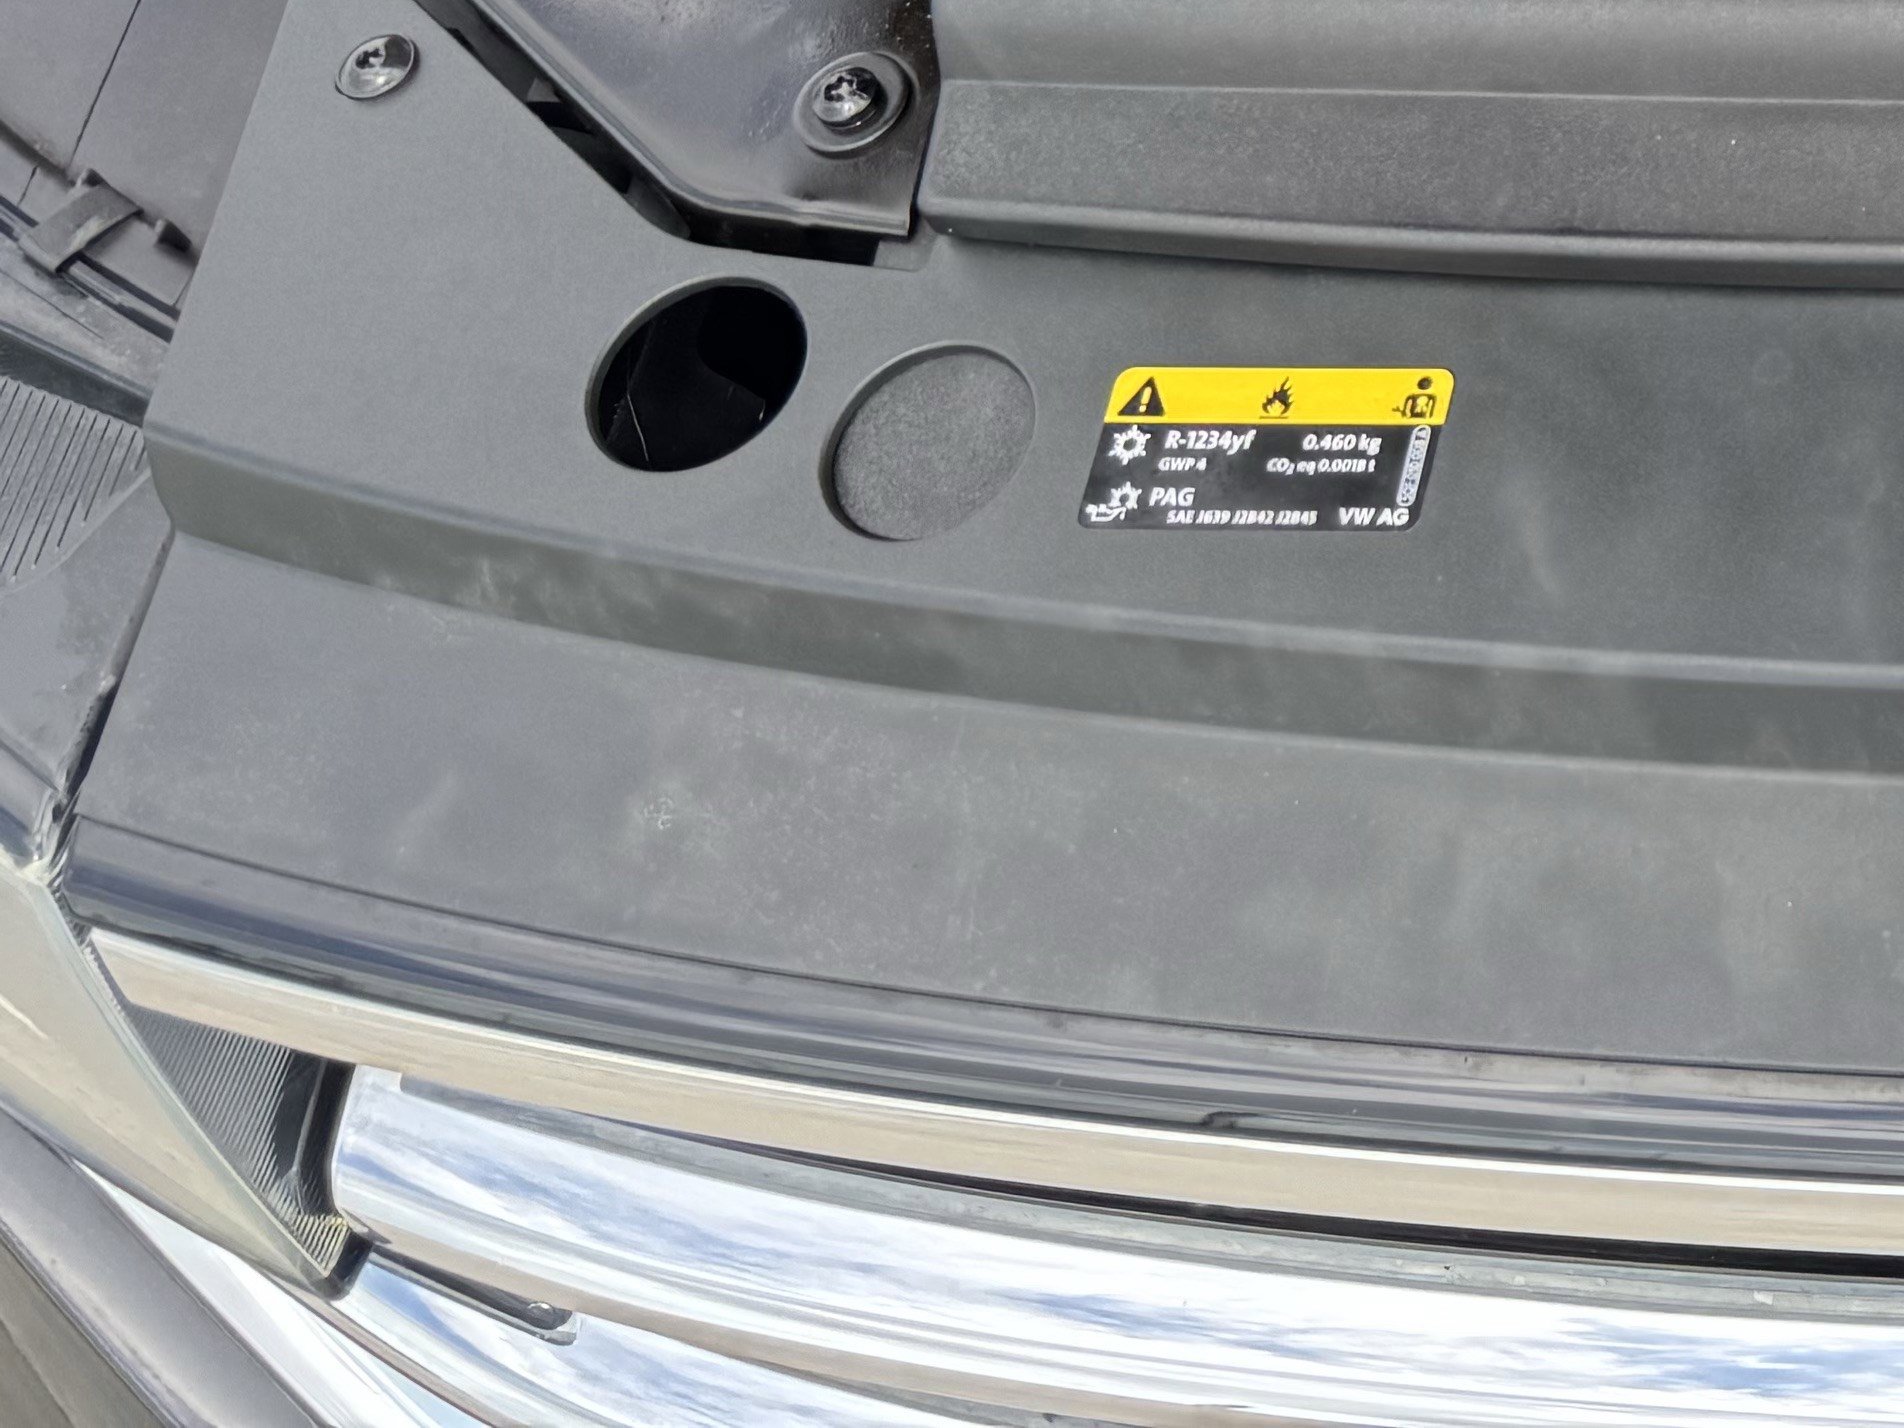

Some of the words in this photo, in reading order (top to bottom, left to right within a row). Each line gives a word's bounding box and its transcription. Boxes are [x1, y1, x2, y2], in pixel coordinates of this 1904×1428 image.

[1164, 429, 1257, 455] R-1234yf
[1302, 434, 1357, 451] 0.460
[1358, 434, 1382, 455] kg
[1158, 458, 1195, 472] GWP
[1296, 460, 1316, 475] eq
[1149, 487, 1195, 507] PAG
[1166, 509, 1195, 524] SAE
[1338, 507, 1375, 525] VW
[1377, 508, 1410, 526] AG
